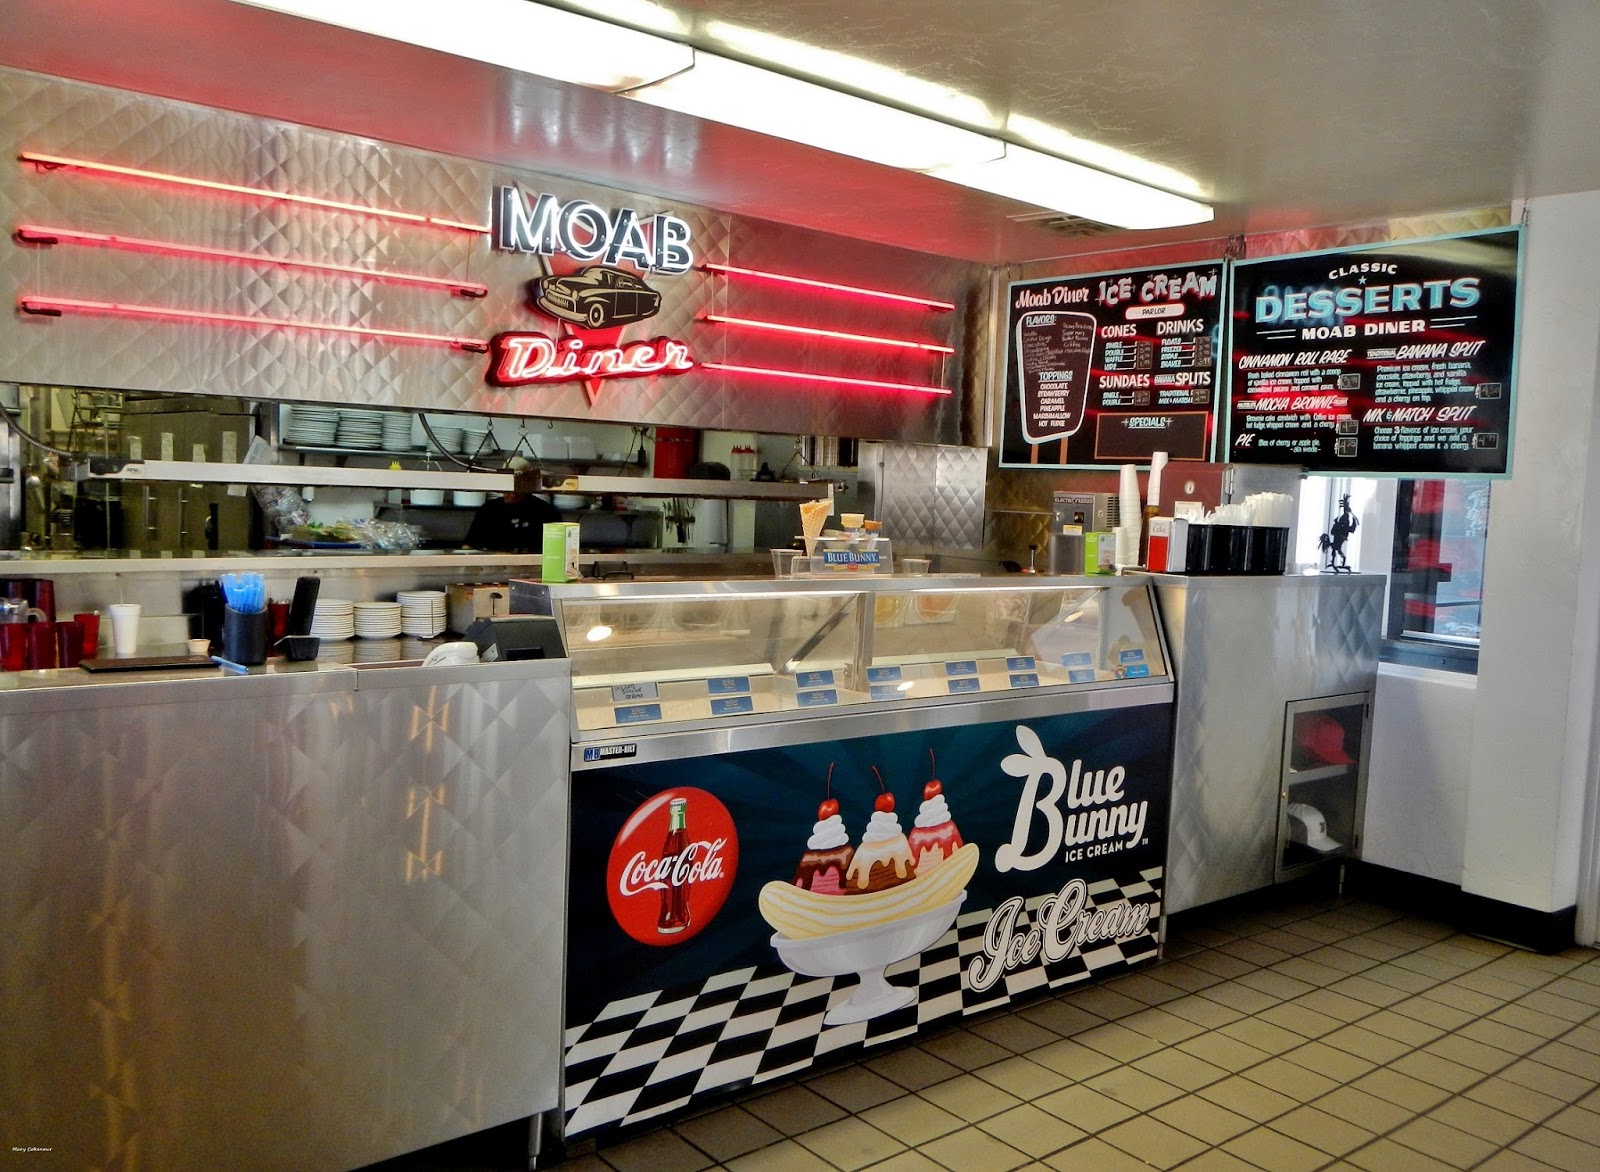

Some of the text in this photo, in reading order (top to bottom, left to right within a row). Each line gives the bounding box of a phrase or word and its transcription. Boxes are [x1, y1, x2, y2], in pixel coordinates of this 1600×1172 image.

[499, 186, 694, 275] MOAB
[1328, 262, 1398, 280] CLASSIC
[1098, 271, 1218, 305] ICE CREAM
[1015, 286, 1090, 309] Moab Diner
[1255, 277, 1481, 324] DESSERTS
[1142, 307, 1166, 315] PARLOR
[1101, 324, 1137, 338] CONES
[1156, 319, 1204, 336] DRINKS
[1302, 320, 1426, 341] MOAB DINER
[1396, 343, 1448, 360] BANANA
[1448, 340, 1486, 357] SPLIT
[500, 336, 694, 382] Diner
[1238, 348, 1352, 370] CINNAMON ROLL RAGE
[1040, 371, 1073, 381] TOPPINGS
[1099, 374, 1150, 388] SUNDAES
[1176, 371, 1211, 386] SPLITS
[1255, 397, 1290, 410] MOCHA
[1291, 395, 1338, 410] BROWNIE
[1393, 395, 1410, 403] cherry
[1363, 408, 1387, 422] MIX
[1391, 407, 1435, 422] MATCH
[1436, 405, 1477, 422] SPLIT
[1128, 418, 1166, 428] SPECIALS
[1235, 434, 1256, 446] PIE
[1152, 526, 1166, 534] Coke
[827, 552, 878, 562] BLUE BUNNY
[1065, 840, 1124, 864] ICE CREAM
[620, 838, 728, 896] Coca-Cola
[968, 878, 1151, 994] Ice Cream
